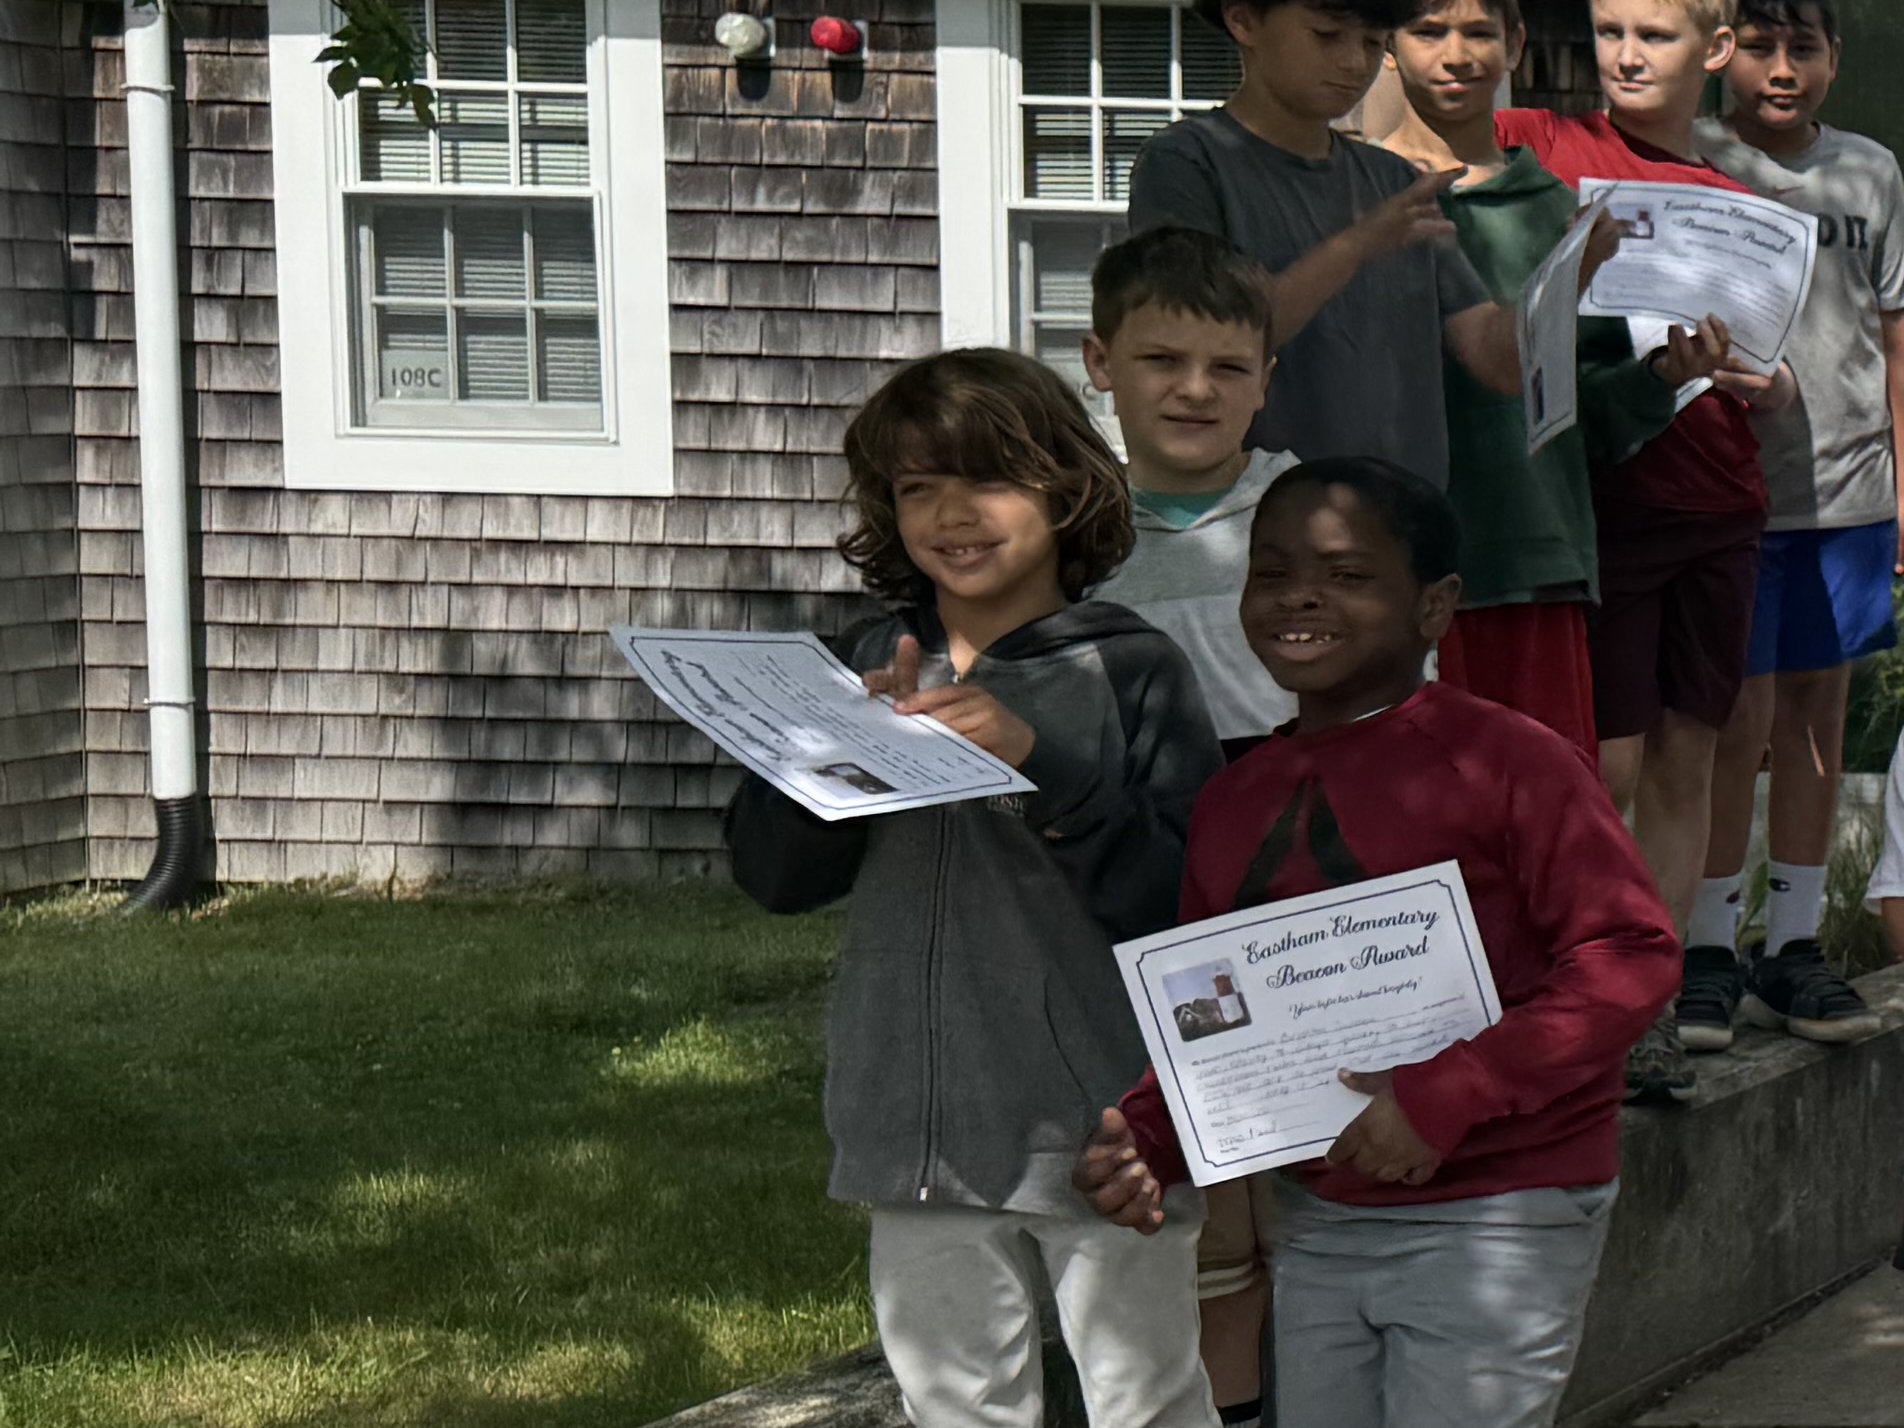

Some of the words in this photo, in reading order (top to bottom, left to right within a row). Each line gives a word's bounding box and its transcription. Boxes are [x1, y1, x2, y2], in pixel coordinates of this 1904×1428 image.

[390, 367, 441, 388] 108C
[1242, 930, 1325, 964] Eastham
[1330, 911, 1437, 937] Elementary
[1267, 963, 1346, 988] Beacon
[1351, 935, 1427, 970] Award
